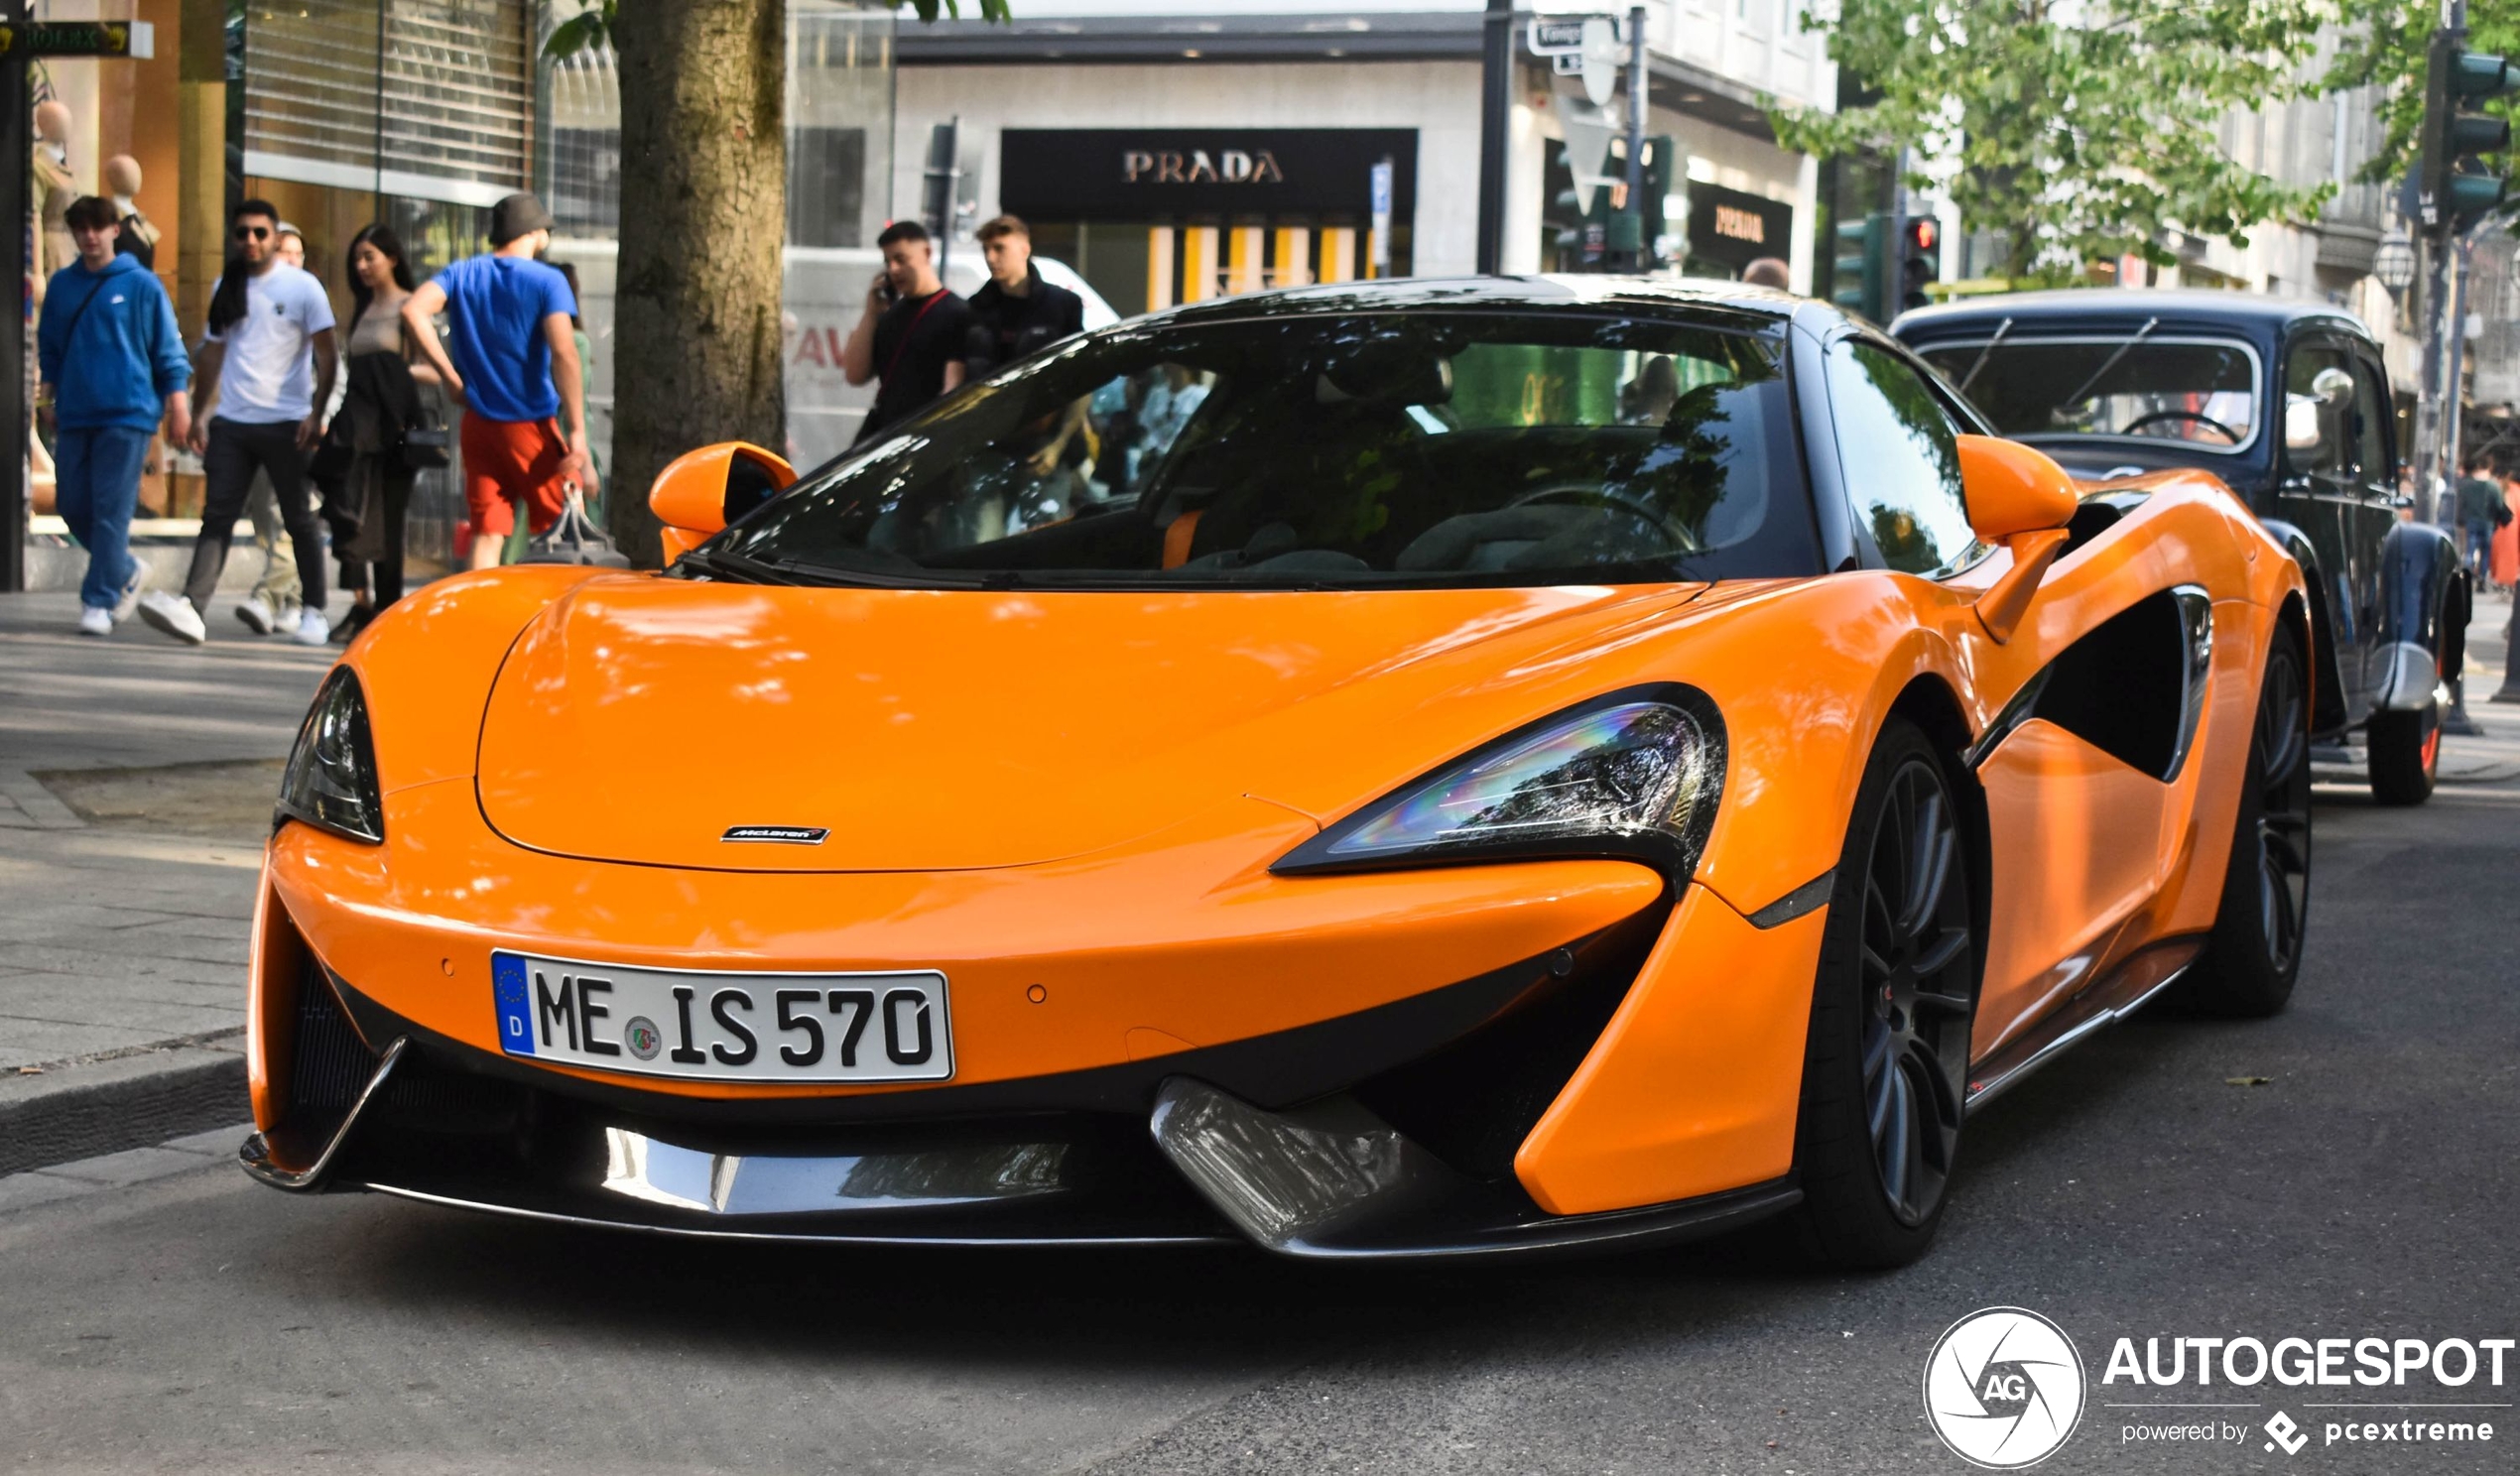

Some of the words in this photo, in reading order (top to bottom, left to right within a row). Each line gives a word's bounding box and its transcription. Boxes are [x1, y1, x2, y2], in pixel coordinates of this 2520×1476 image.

[1122, 150, 1284, 184] PRADA
[732, 829, 810, 838] McLaren
[509, 1015, 523, 1037] D
[535, 969, 620, 1055] ME
[670, 986, 758, 1066] IS
[775, 987, 934, 1067] 570
